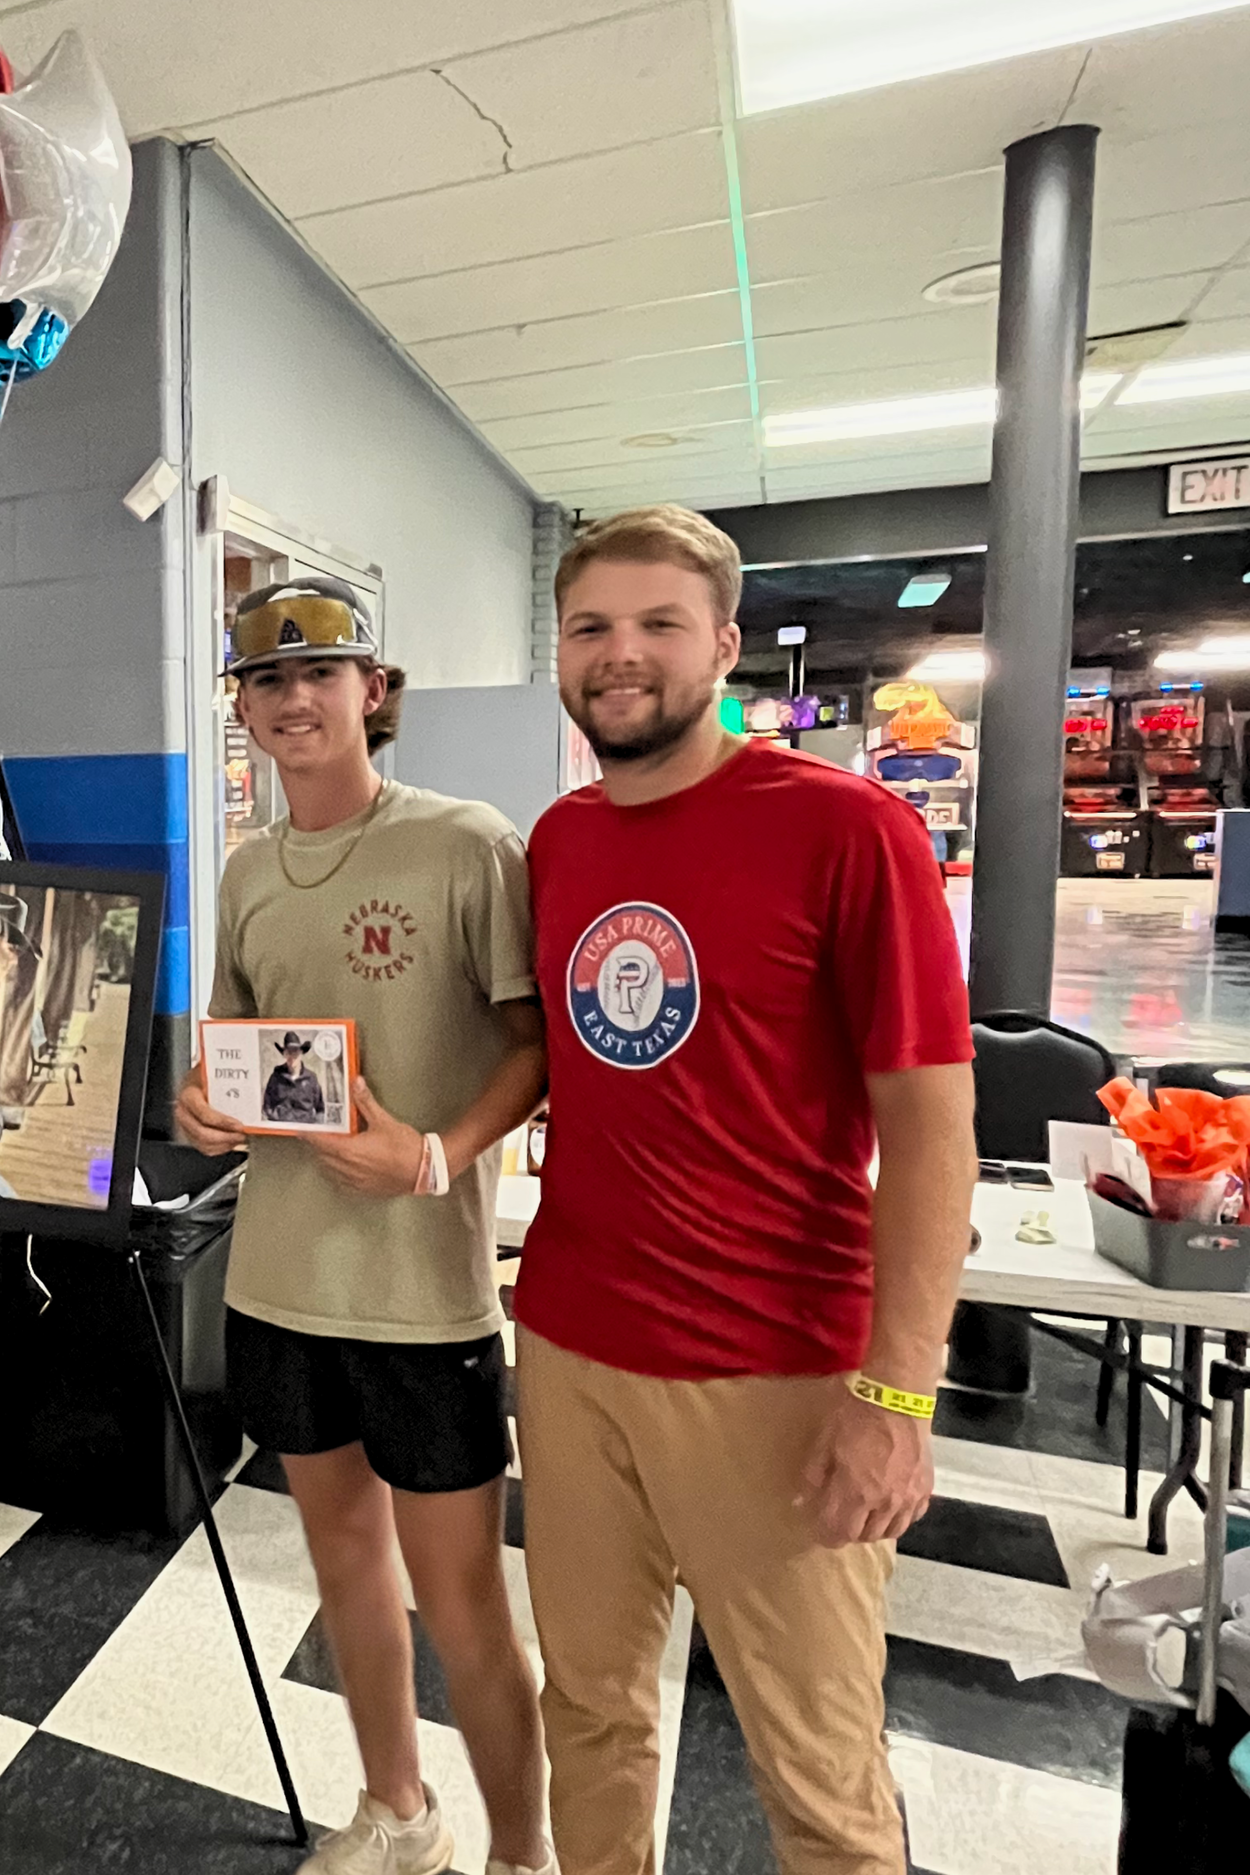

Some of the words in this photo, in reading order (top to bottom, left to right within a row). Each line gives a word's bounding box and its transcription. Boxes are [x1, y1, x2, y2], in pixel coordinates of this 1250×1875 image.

[1180, 464, 1249, 504] EXIT
[342, 898, 417, 938] NEBRASKA
[362, 925, 392, 955] N
[584, 925, 619, 961] USA
[621, 916, 678, 959] PRIME
[344, 950, 414, 982] HUSKERS
[583, 1010, 628, 1055] EAST
[632, 1006, 682, 1057] TEXAS
[216, 1049, 241, 1060] THE
[214, 1068, 250, 1080] DIRTY
